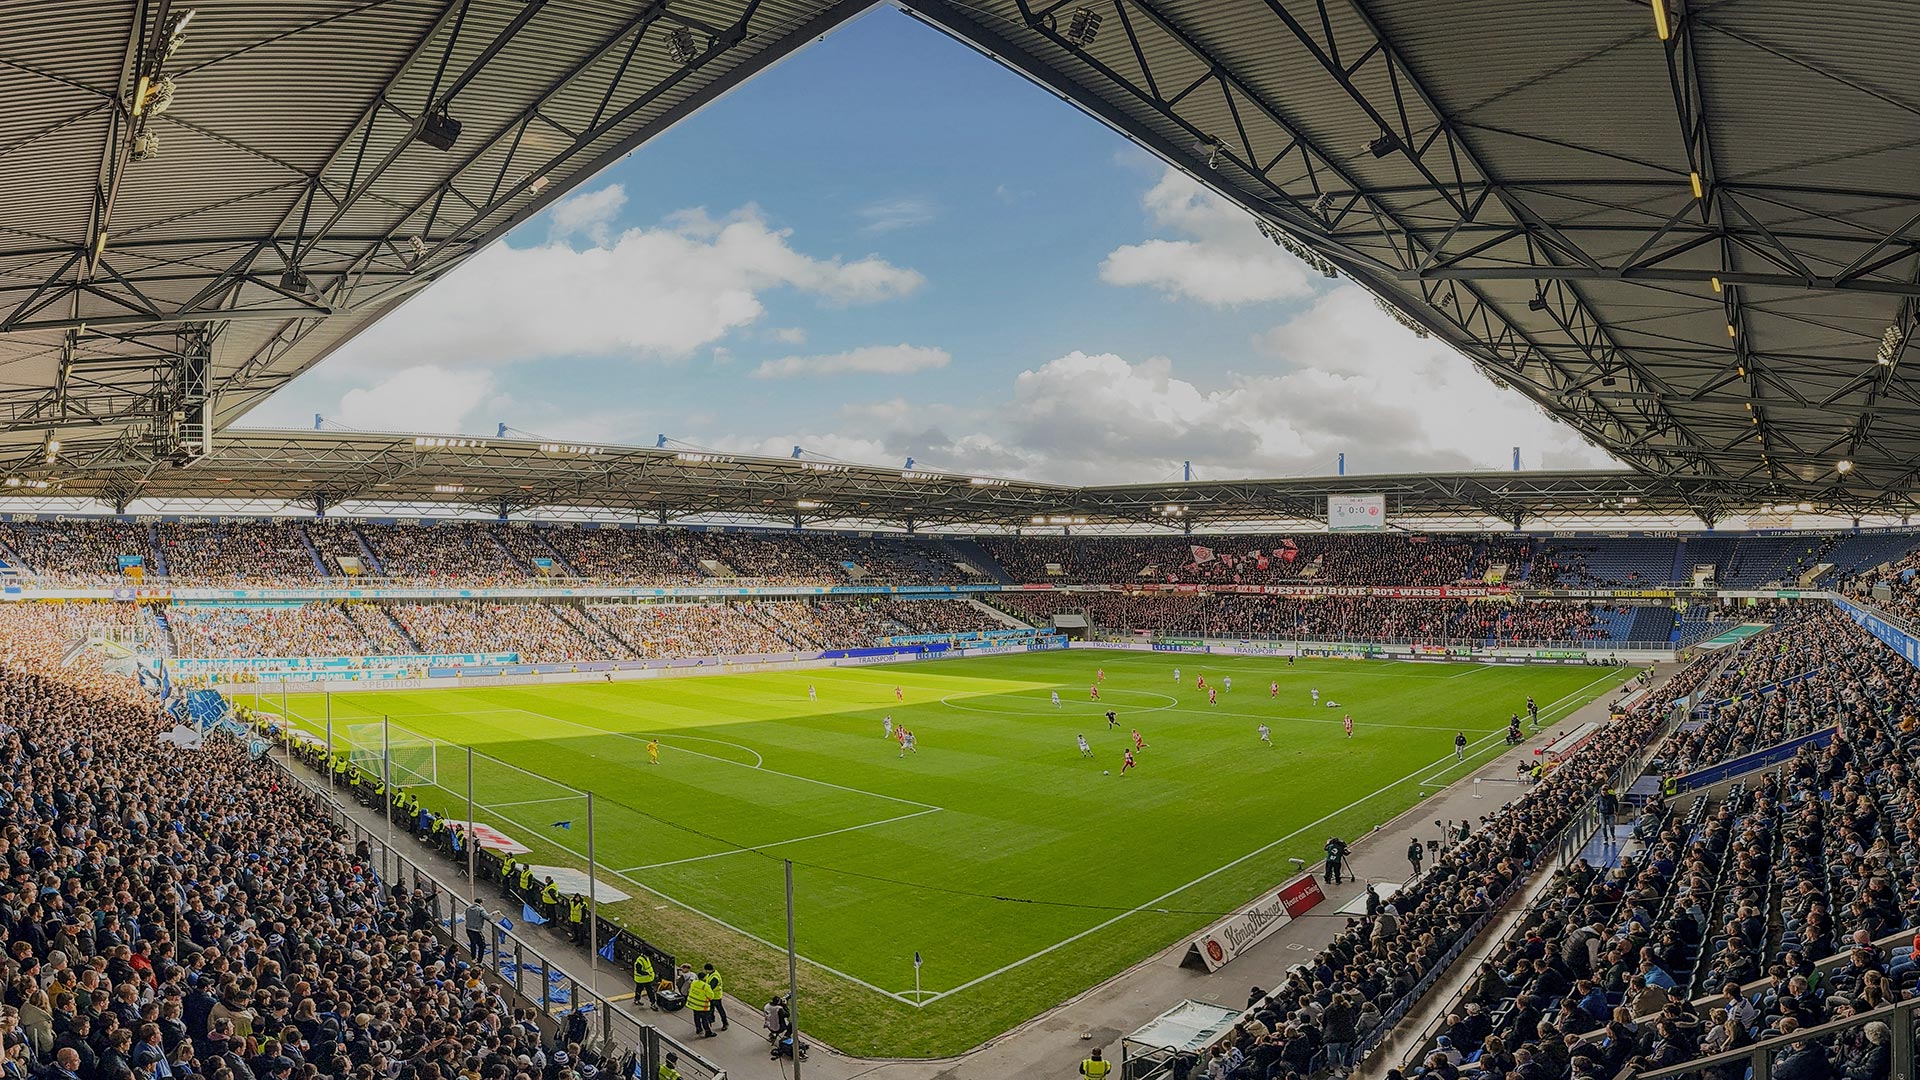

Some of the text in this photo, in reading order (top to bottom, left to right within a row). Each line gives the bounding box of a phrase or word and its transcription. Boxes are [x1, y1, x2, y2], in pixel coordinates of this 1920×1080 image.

[1348, 506, 1365, 514] 0:0
[179, 515, 211, 524] Sinalco
[1815, 529, 1842, 538] Duisburg
[1372, 587, 1441, 596] ROT-WEISS
[1445, 588, 1486, 596] ESSEN
[1568, 589, 1590, 597] TICKETS
[981, 646, 1013, 654] TRANSPORT
[1232, 647, 1278, 655] TRANSPORT
[859, 655, 896, 663] TRANSPORT
[916, 652, 941, 660] LICHTE
[370, 656, 465, 667] schauinsland reisen
[315, 672, 346, 682] reisen
[362, 679, 421, 689] SPEDITION
[1284, 896, 1299, 909] Heute
[1304, 884, 1320, 896] König
[1247, 901, 1283, 931] Pilsener
